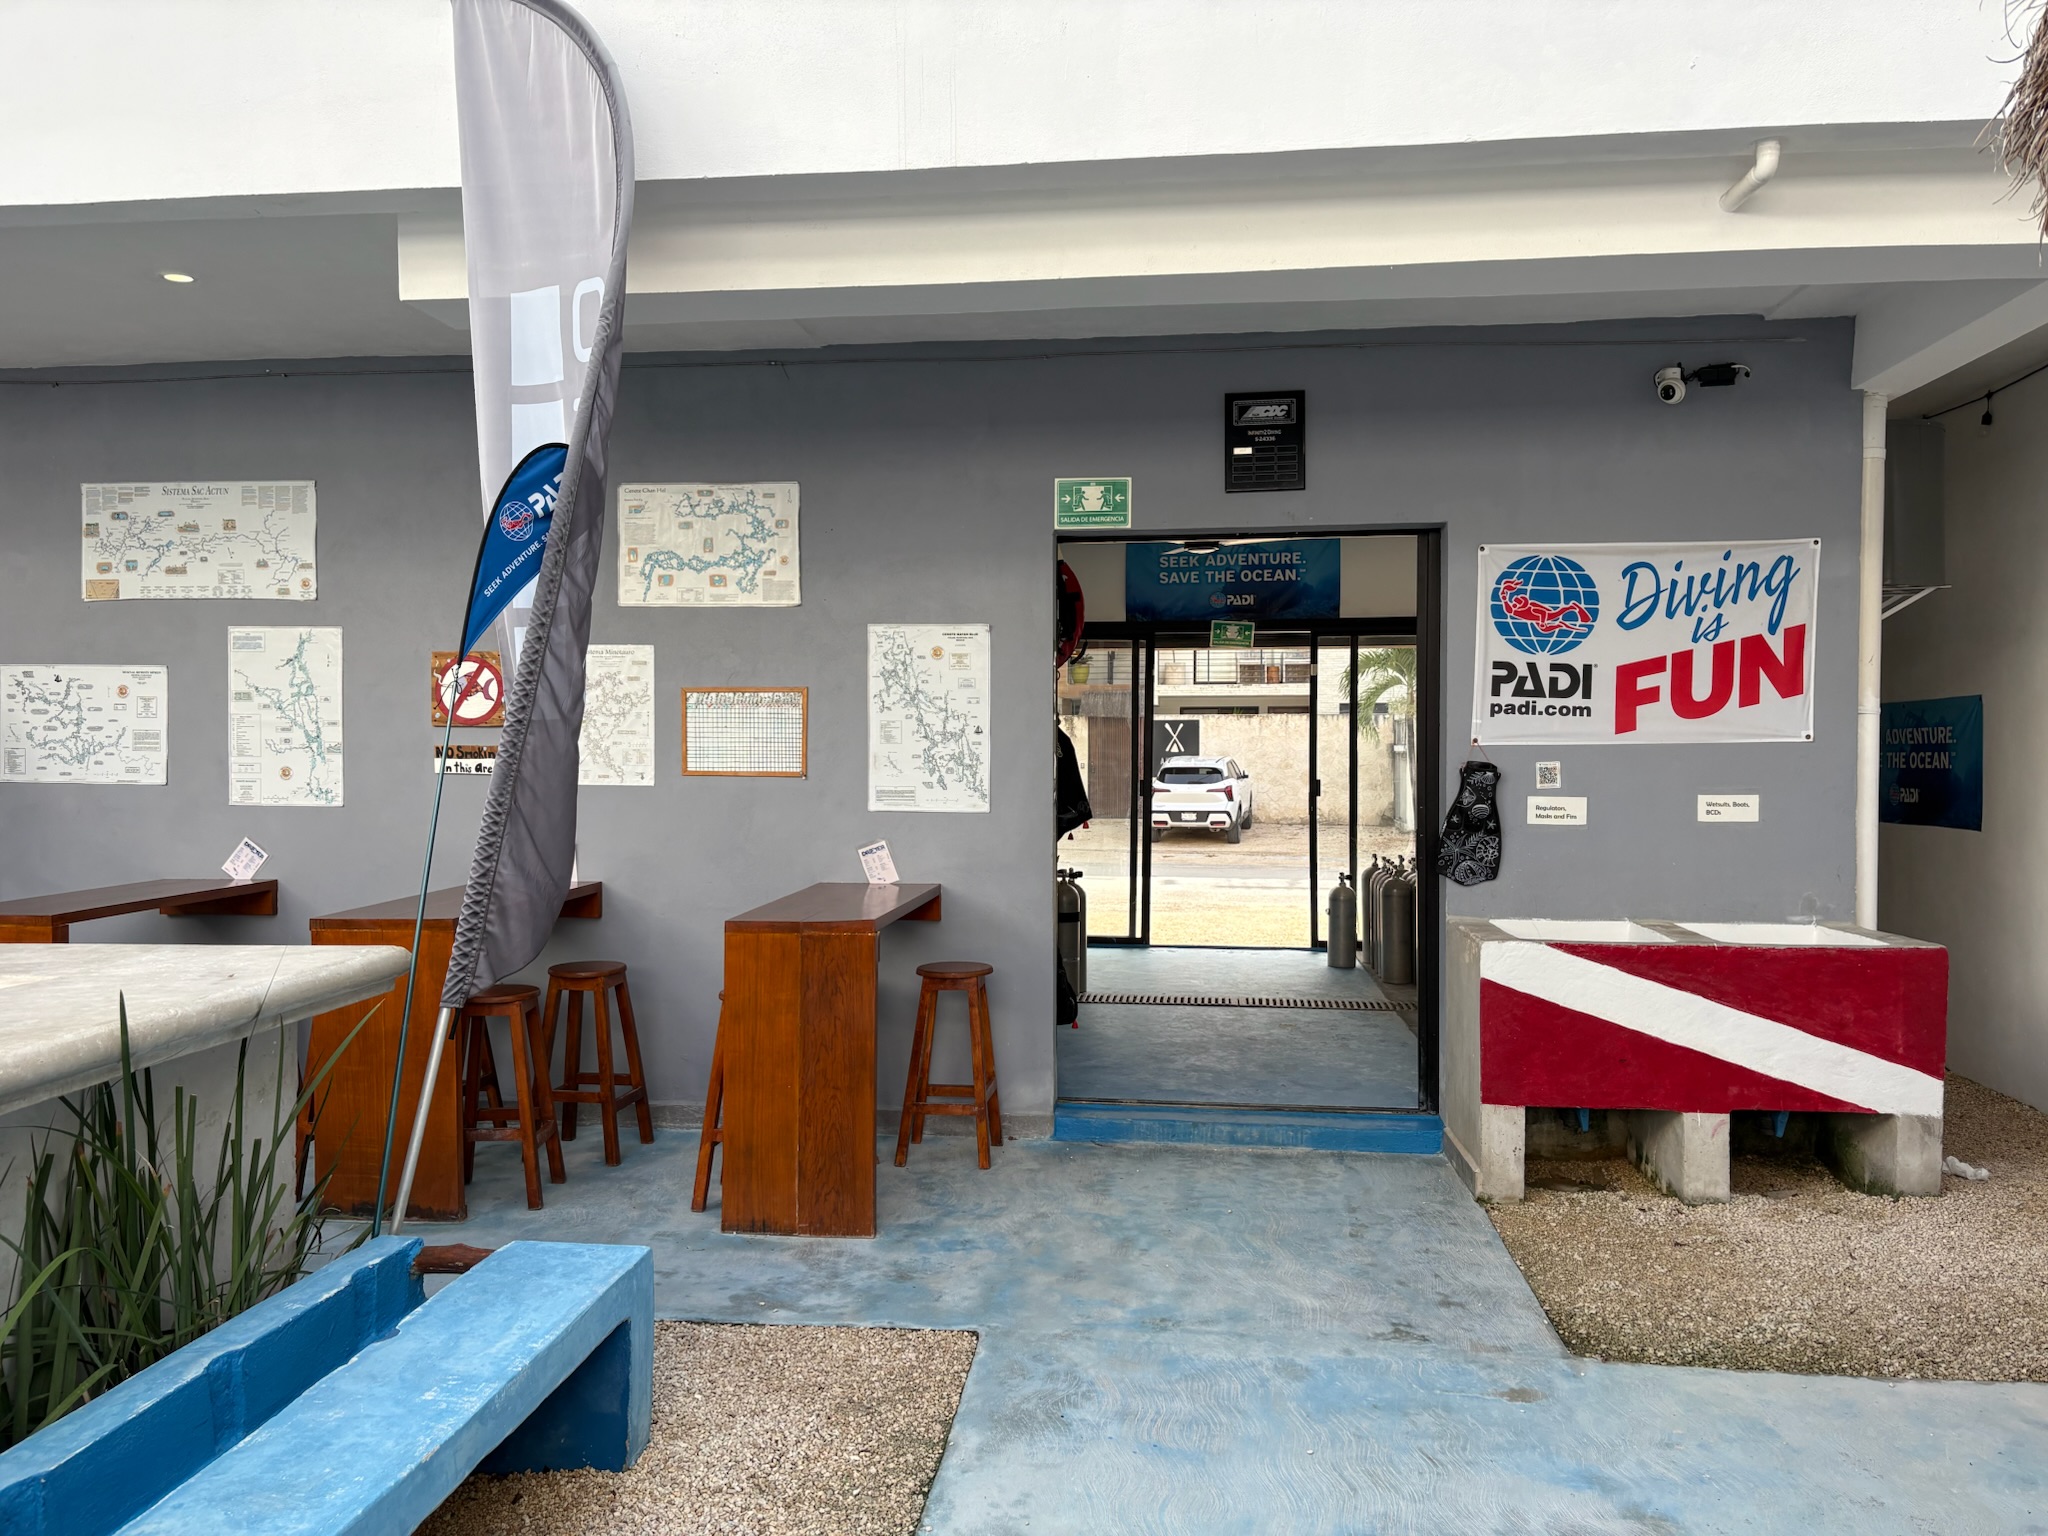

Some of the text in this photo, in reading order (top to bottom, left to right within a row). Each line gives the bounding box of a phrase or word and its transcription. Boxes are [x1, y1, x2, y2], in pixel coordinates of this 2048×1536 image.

[483, 574, 503, 598] SEEK
[502, 540, 544, 578] ADVENTURE.
[1159, 552, 1306, 568] SEEK ADVENTURE.
[1159, 571, 1200, 584] SAVE
[1205, 570, 1235, 583] THE
[1226, 594, 1255, 606] PADI
[1616, 550, 1800, 636] Diving
[1691, 603, 1729, 644] is
[1491, 661, 1593, 699] PADI
[1615, 623, 1806, 735] FUN
[1490, 700, 1592, 718] padi.com
[1885, 726, 1957, 744] ADVENTURE.
[454, 761, 472, 773] this
[1887, 752, 1906, 768] THE
[1900, 787, 1919, 803] PADI
